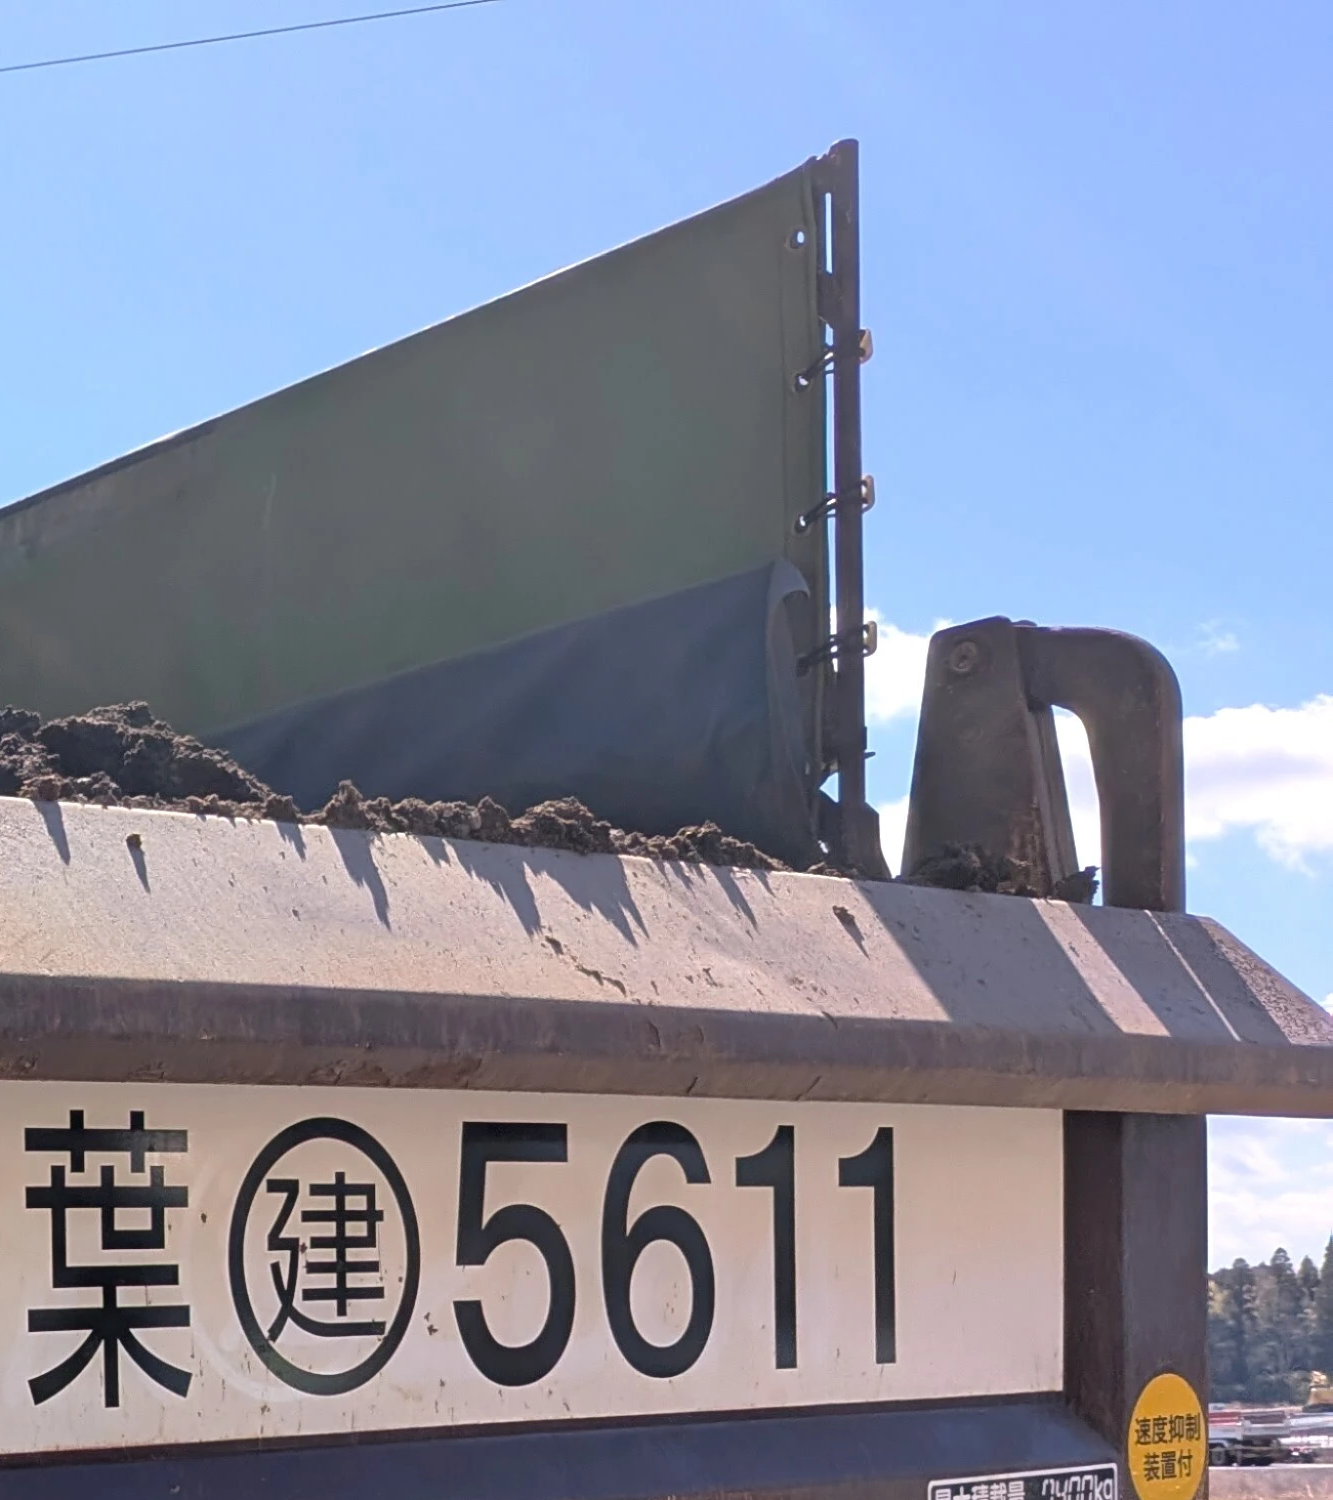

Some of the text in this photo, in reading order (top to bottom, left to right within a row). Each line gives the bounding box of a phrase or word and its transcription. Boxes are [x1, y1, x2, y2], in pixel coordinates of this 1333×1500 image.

[1134, 1413, 1201, 1445] 速度抑制
[1143, 1449, 1194, 1482] 装置付
